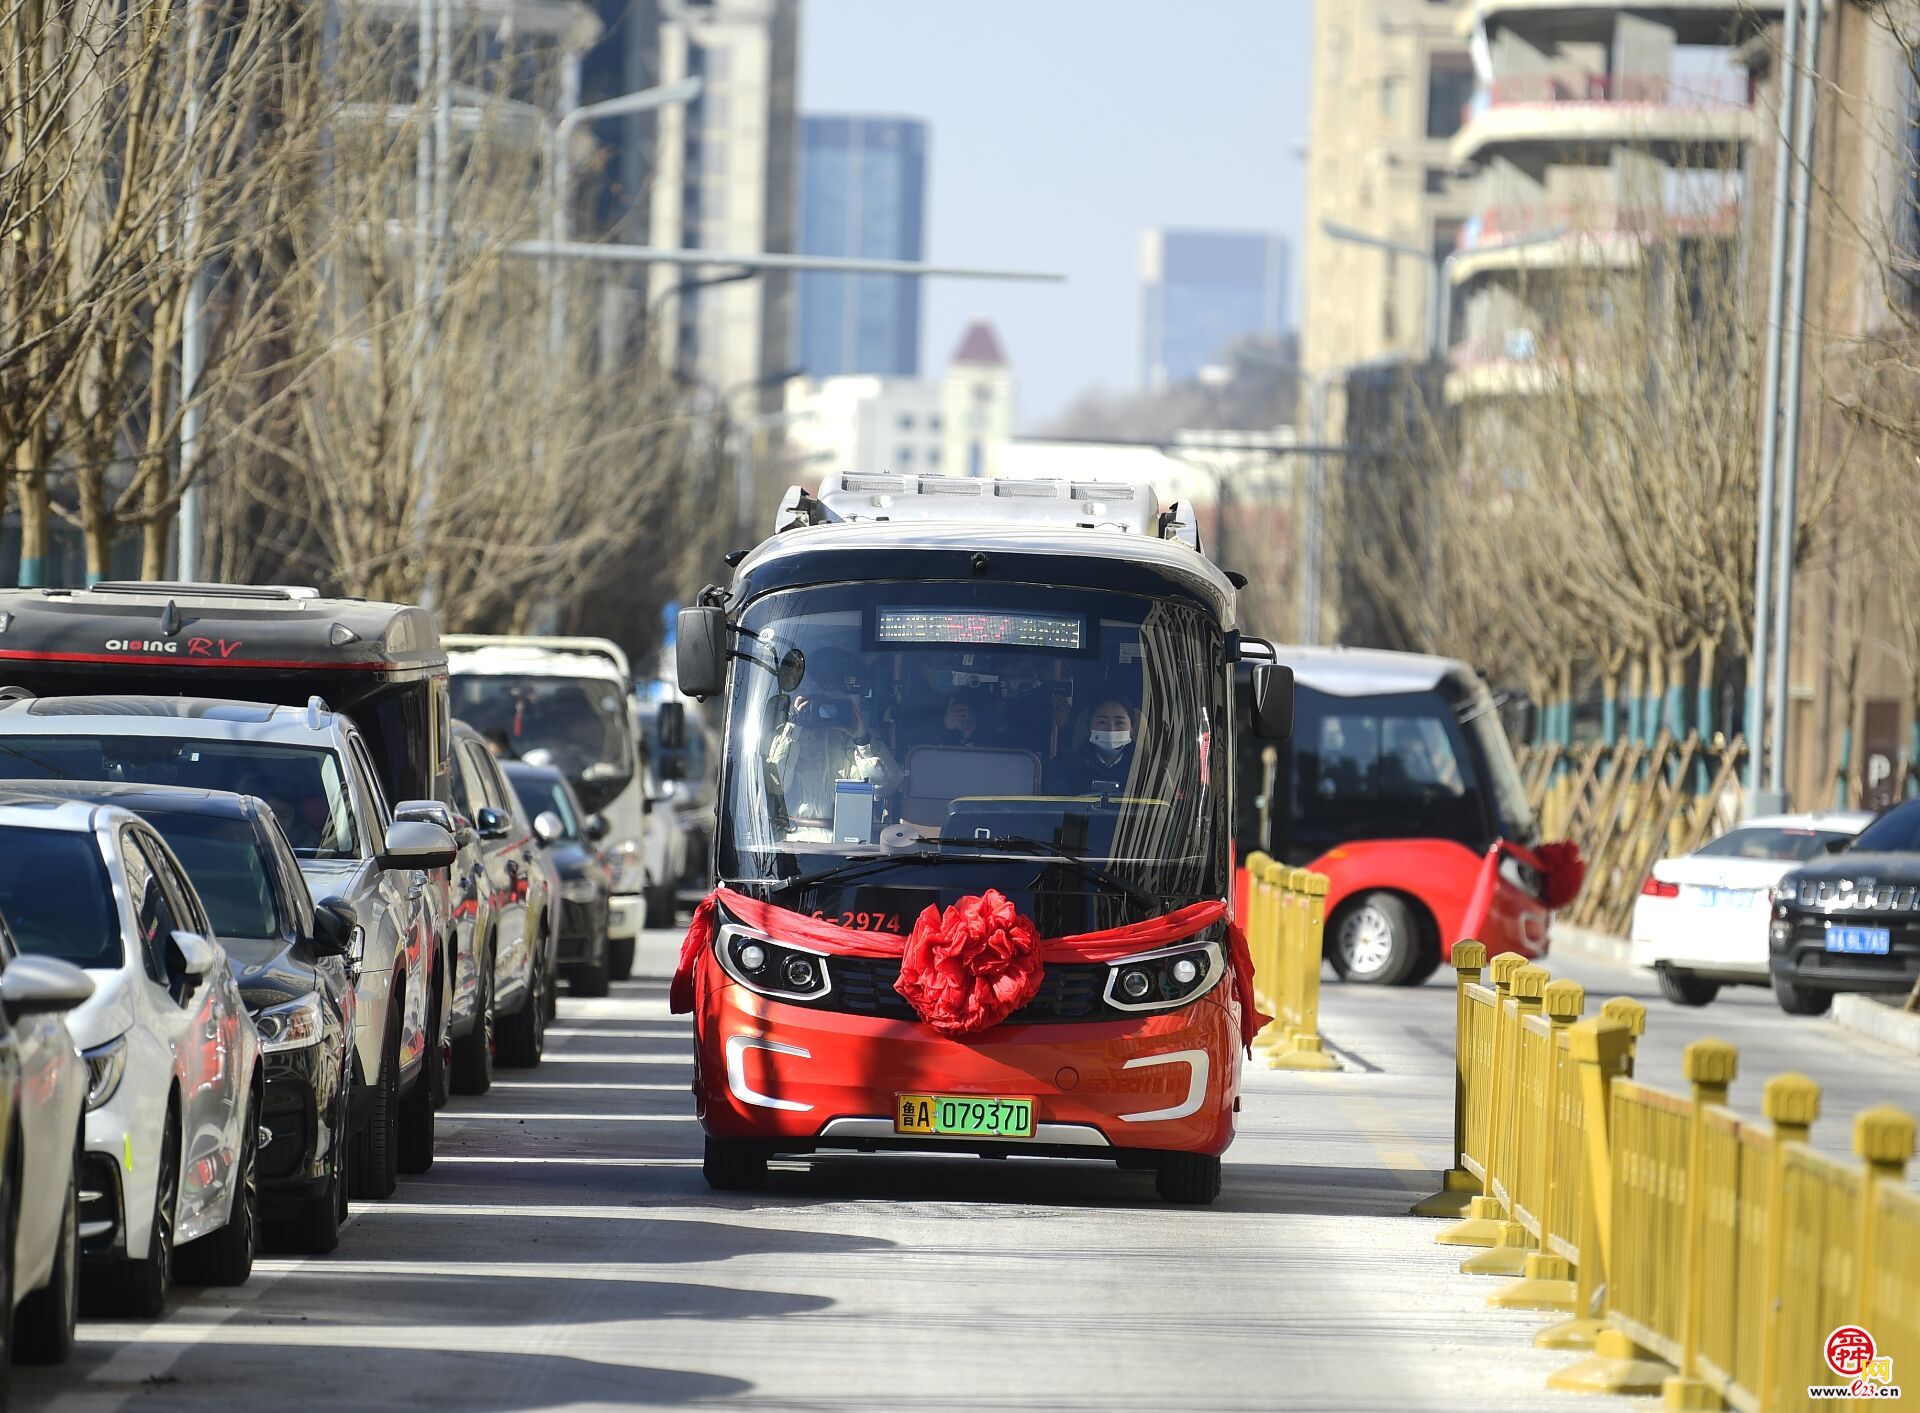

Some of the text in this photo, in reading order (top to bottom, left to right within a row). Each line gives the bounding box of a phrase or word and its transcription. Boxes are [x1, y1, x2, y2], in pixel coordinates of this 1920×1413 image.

[187, 637, 242, 657] RV
[1869, 753, 1891, 789] P
[902, 1101, 1029, 1131] 鲁A 07937D
